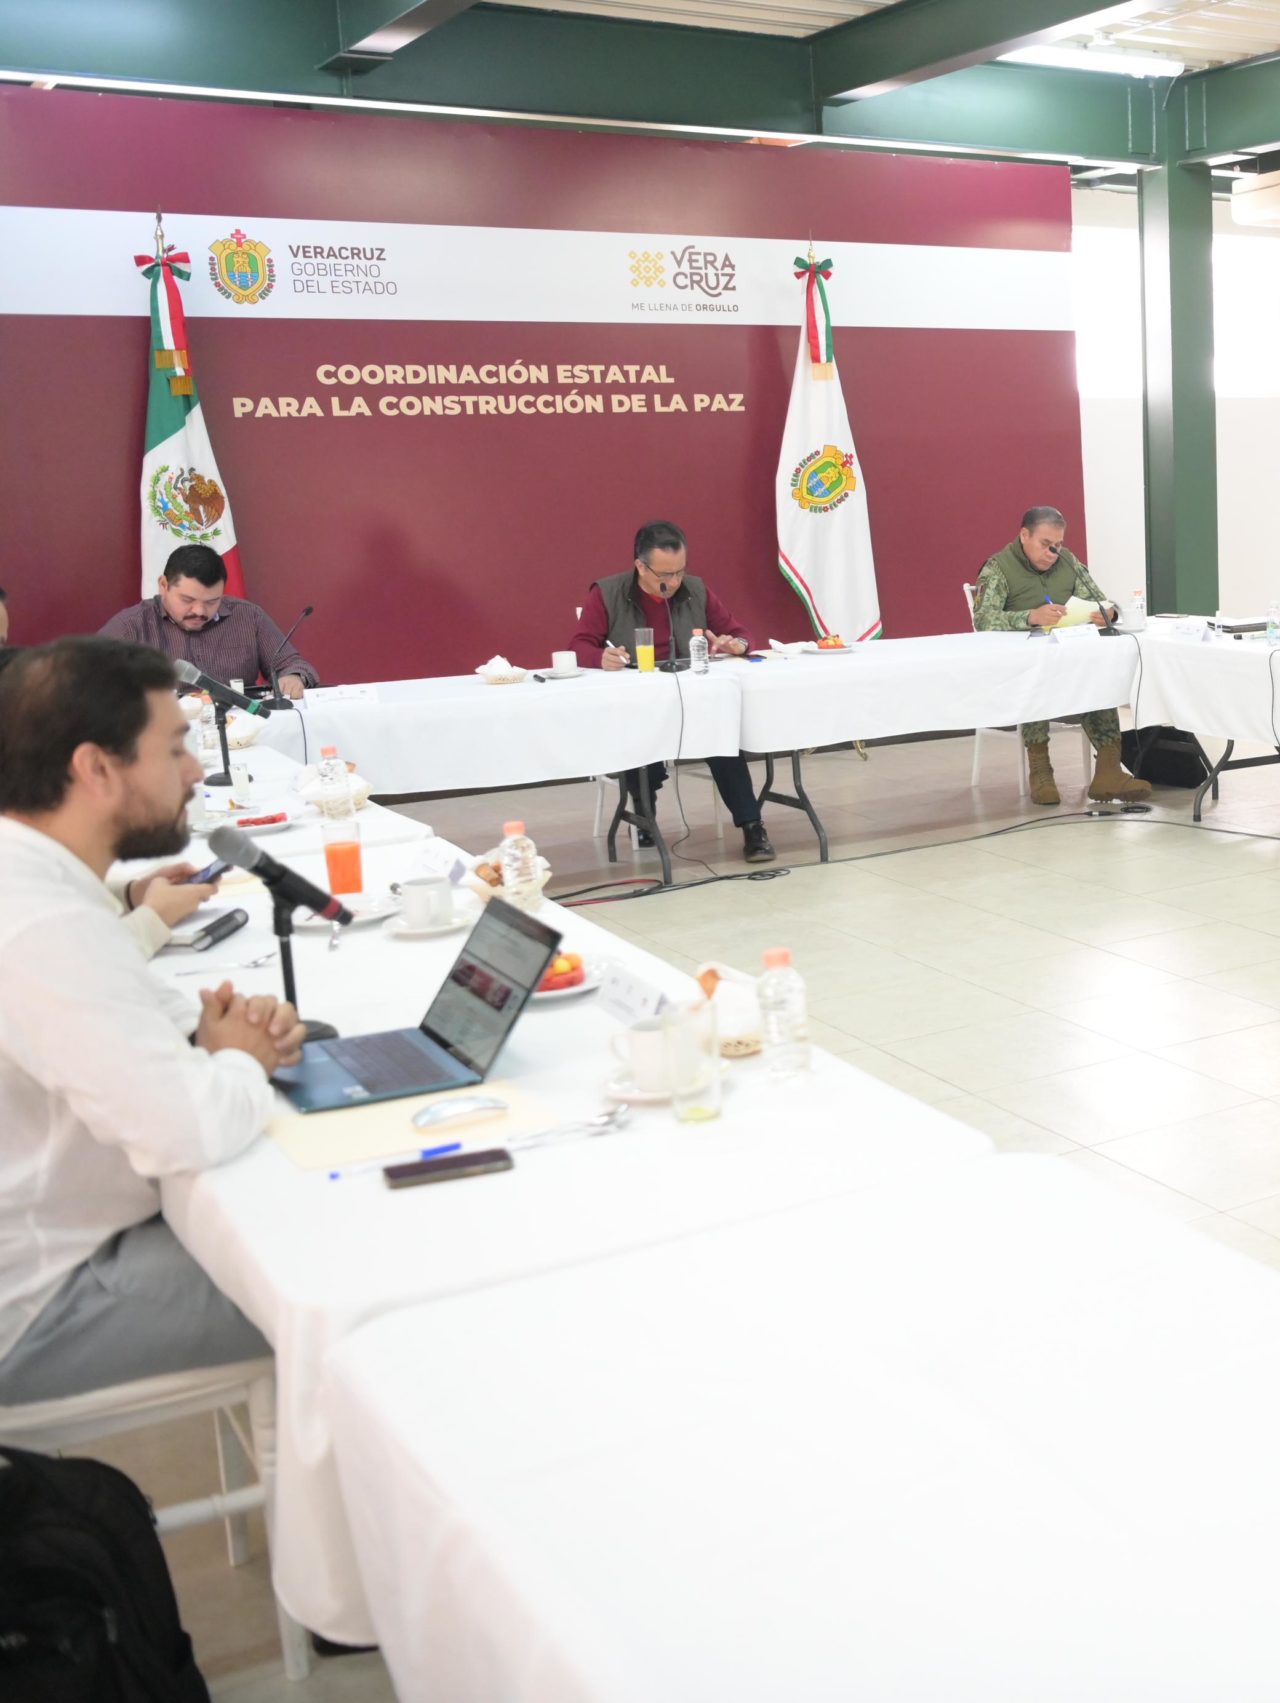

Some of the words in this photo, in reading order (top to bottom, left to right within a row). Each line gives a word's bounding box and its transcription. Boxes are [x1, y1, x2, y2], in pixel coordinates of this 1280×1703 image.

[288, 245, 386, 261] VERACRUZ
[670, 245, 736, 271] VERA
[291, 262, 381, 278] GOBIERNO
[293, 279, 327, 294] DEL
[330, 280, 398, 295] ESTADO
[672, 272, 737, 297] CRUZ
[631, 303, 646, 311] ME
[648, 303, 679, 312] LLENA
[681, 304, 693, 312] DE
[695, 304, 739, 312] ORGULLO
[316, 359, 549, 385] COORDINACIÓN
[556, 365, 675, 383] ESTATAL
[232, 397, 324, 417] PARA
[331, 397, 373, 416] LA
[378, 389, 604, 416] CONSTRUCCIÓN
[610, 395, 648, 413] DE
[653, 394, 688, 413] LA
[693, 393, 746, 412] PAZ
